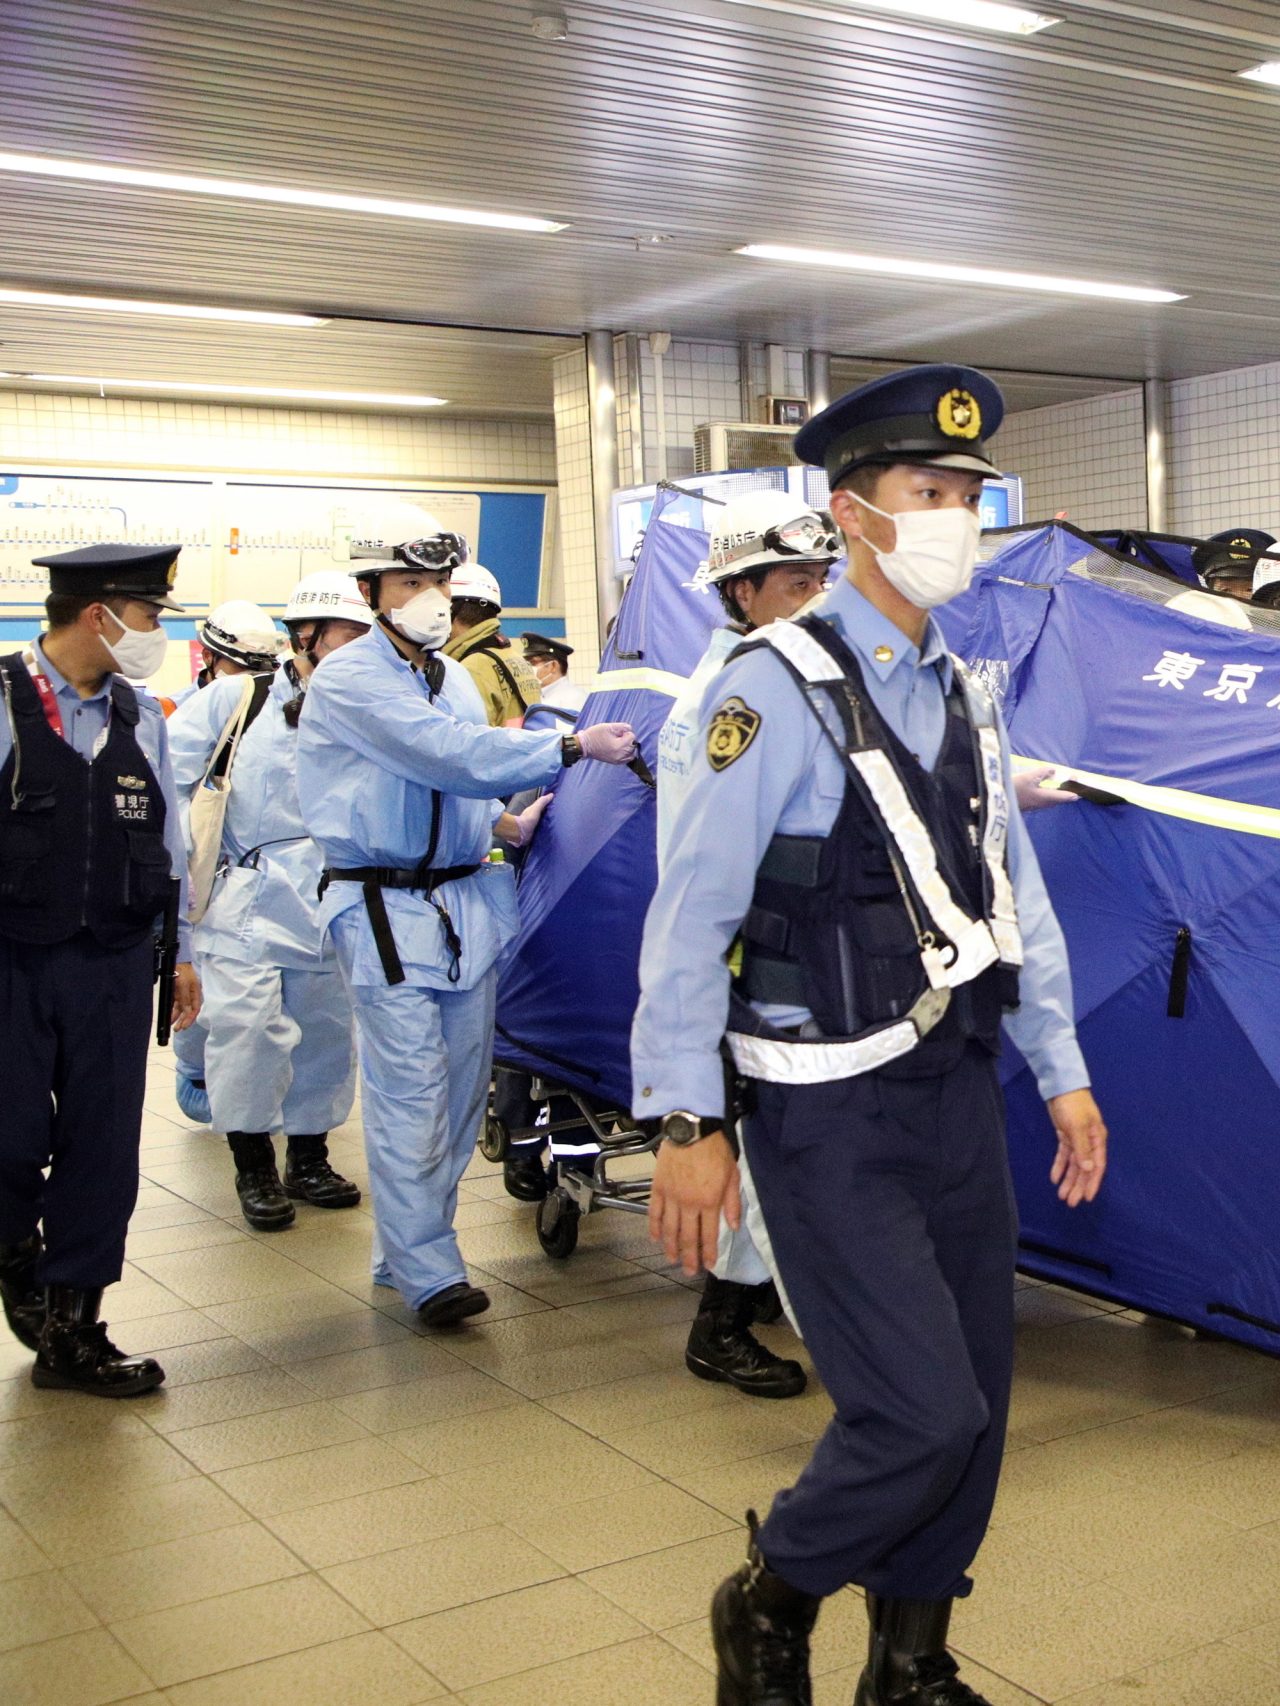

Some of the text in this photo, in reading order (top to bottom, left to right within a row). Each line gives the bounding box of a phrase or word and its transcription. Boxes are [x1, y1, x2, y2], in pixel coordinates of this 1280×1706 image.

[115, 794, 149, 809] 警視庁
[118, 810, 147, 820] POLICE
